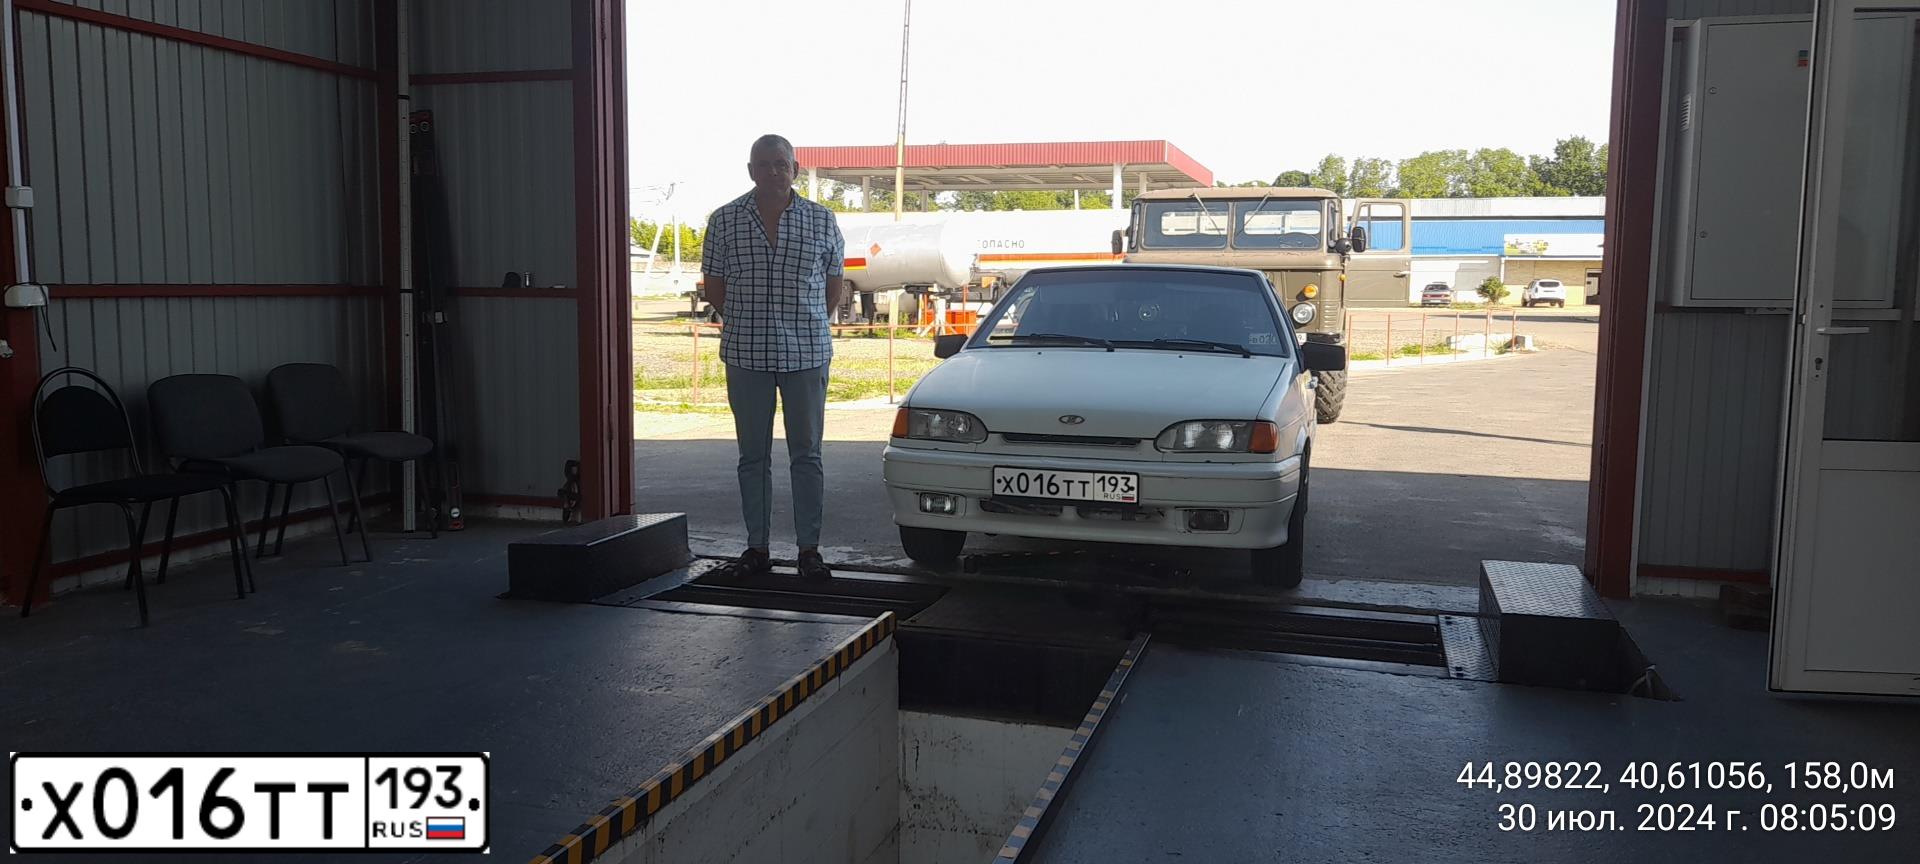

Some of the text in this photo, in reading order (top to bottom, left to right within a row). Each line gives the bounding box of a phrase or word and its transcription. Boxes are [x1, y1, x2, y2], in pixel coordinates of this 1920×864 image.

[1002, 472, 1132, 497] Х016ТТ 193
[1103, 492, 1121, 500] RUS
